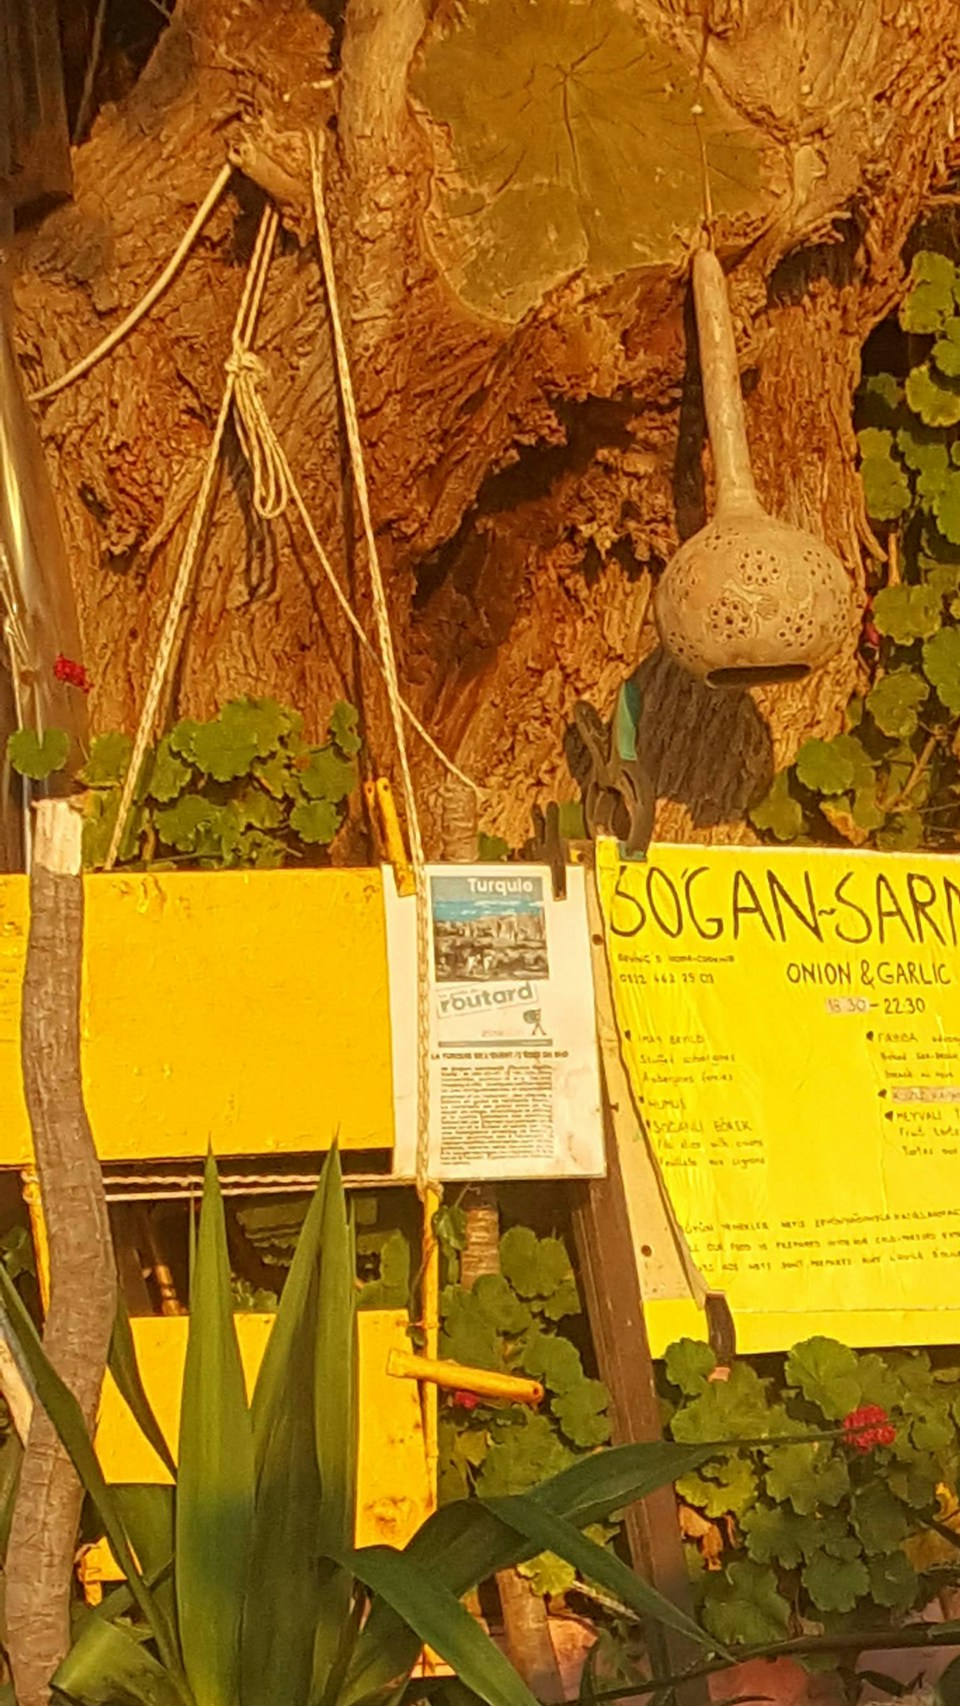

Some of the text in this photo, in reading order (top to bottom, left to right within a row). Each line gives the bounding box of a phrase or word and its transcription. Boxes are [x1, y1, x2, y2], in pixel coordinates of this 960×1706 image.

[786, 959, 951, 989] ONION & GARLIC
[440, 982, 533, 1013] routard
